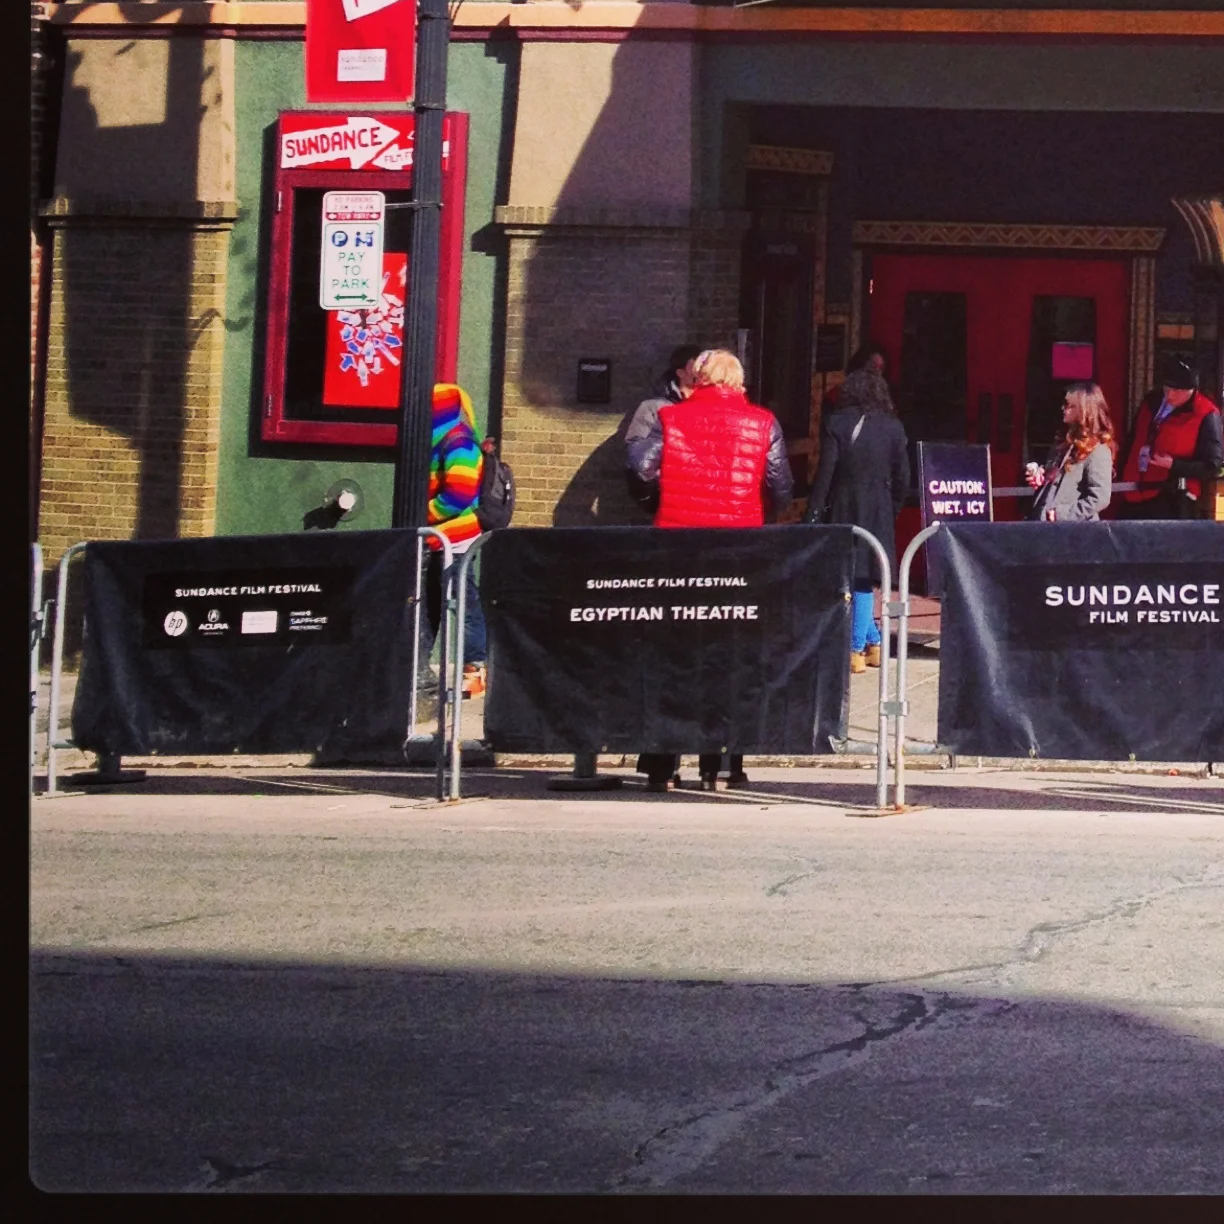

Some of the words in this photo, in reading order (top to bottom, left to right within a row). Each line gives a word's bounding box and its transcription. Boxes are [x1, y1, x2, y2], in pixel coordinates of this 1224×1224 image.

[285, 126, 383, 159] SUNDANCE
[337, 251, 366, 262] PAY
[344, 265, 361, 276] TO
[332, 278, 370, 289] PARK
[931, 500, 964, 516] WET,
[967, 500, 986, 515] ICY
[586, 578, 655, 590] SUNDANCE
[657, 577, 686, 588] FILM
[688, 576, 748, 587] FESTIVAL
[174, 586, 238, 598] SUNDANCE
[240, 586, 266, 595] FILM
[268, 584, 322, 594] FESTIVAL
[1045, 583, 1221, 607] SUNDANCE
[570, 606, 664, 622] EGYPTIAN
[671, 605, 759, 620] THEATRE
[1089, 610, 1129, 624] FILM
[1137, 610, 1221, 623] FESTIVAL
[198, 623, 230, 631] ACURA
